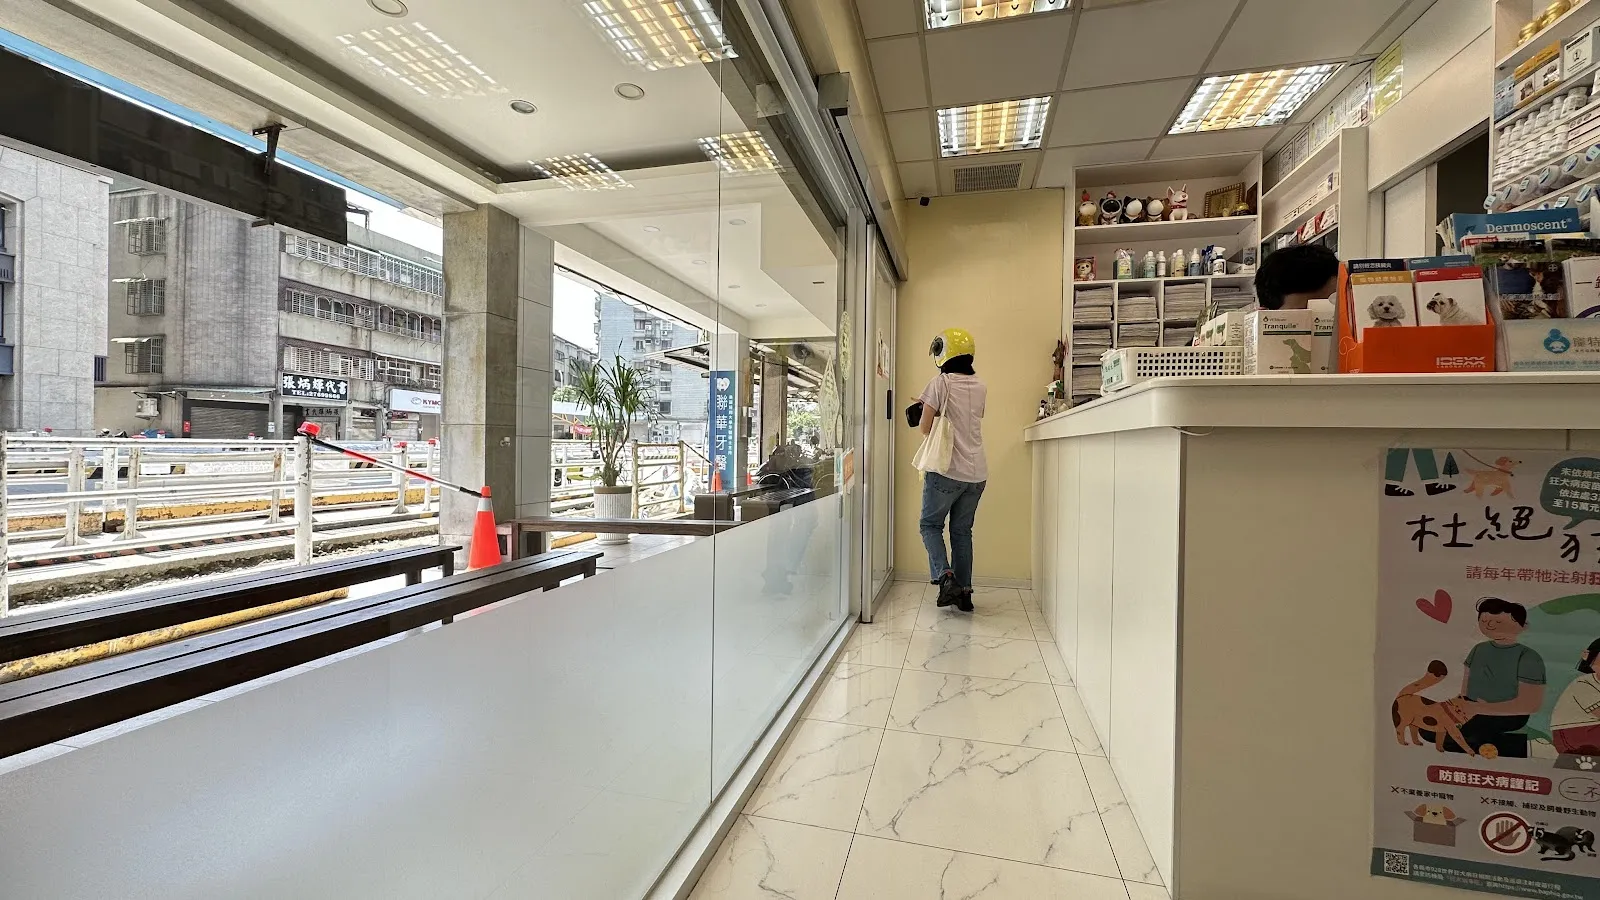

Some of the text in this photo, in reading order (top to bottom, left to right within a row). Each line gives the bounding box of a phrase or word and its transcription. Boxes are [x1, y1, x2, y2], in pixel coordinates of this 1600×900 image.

[1436, 356, 1486, 365] IDEXX
[283, 375, 347, 395] 張炳輝代書
